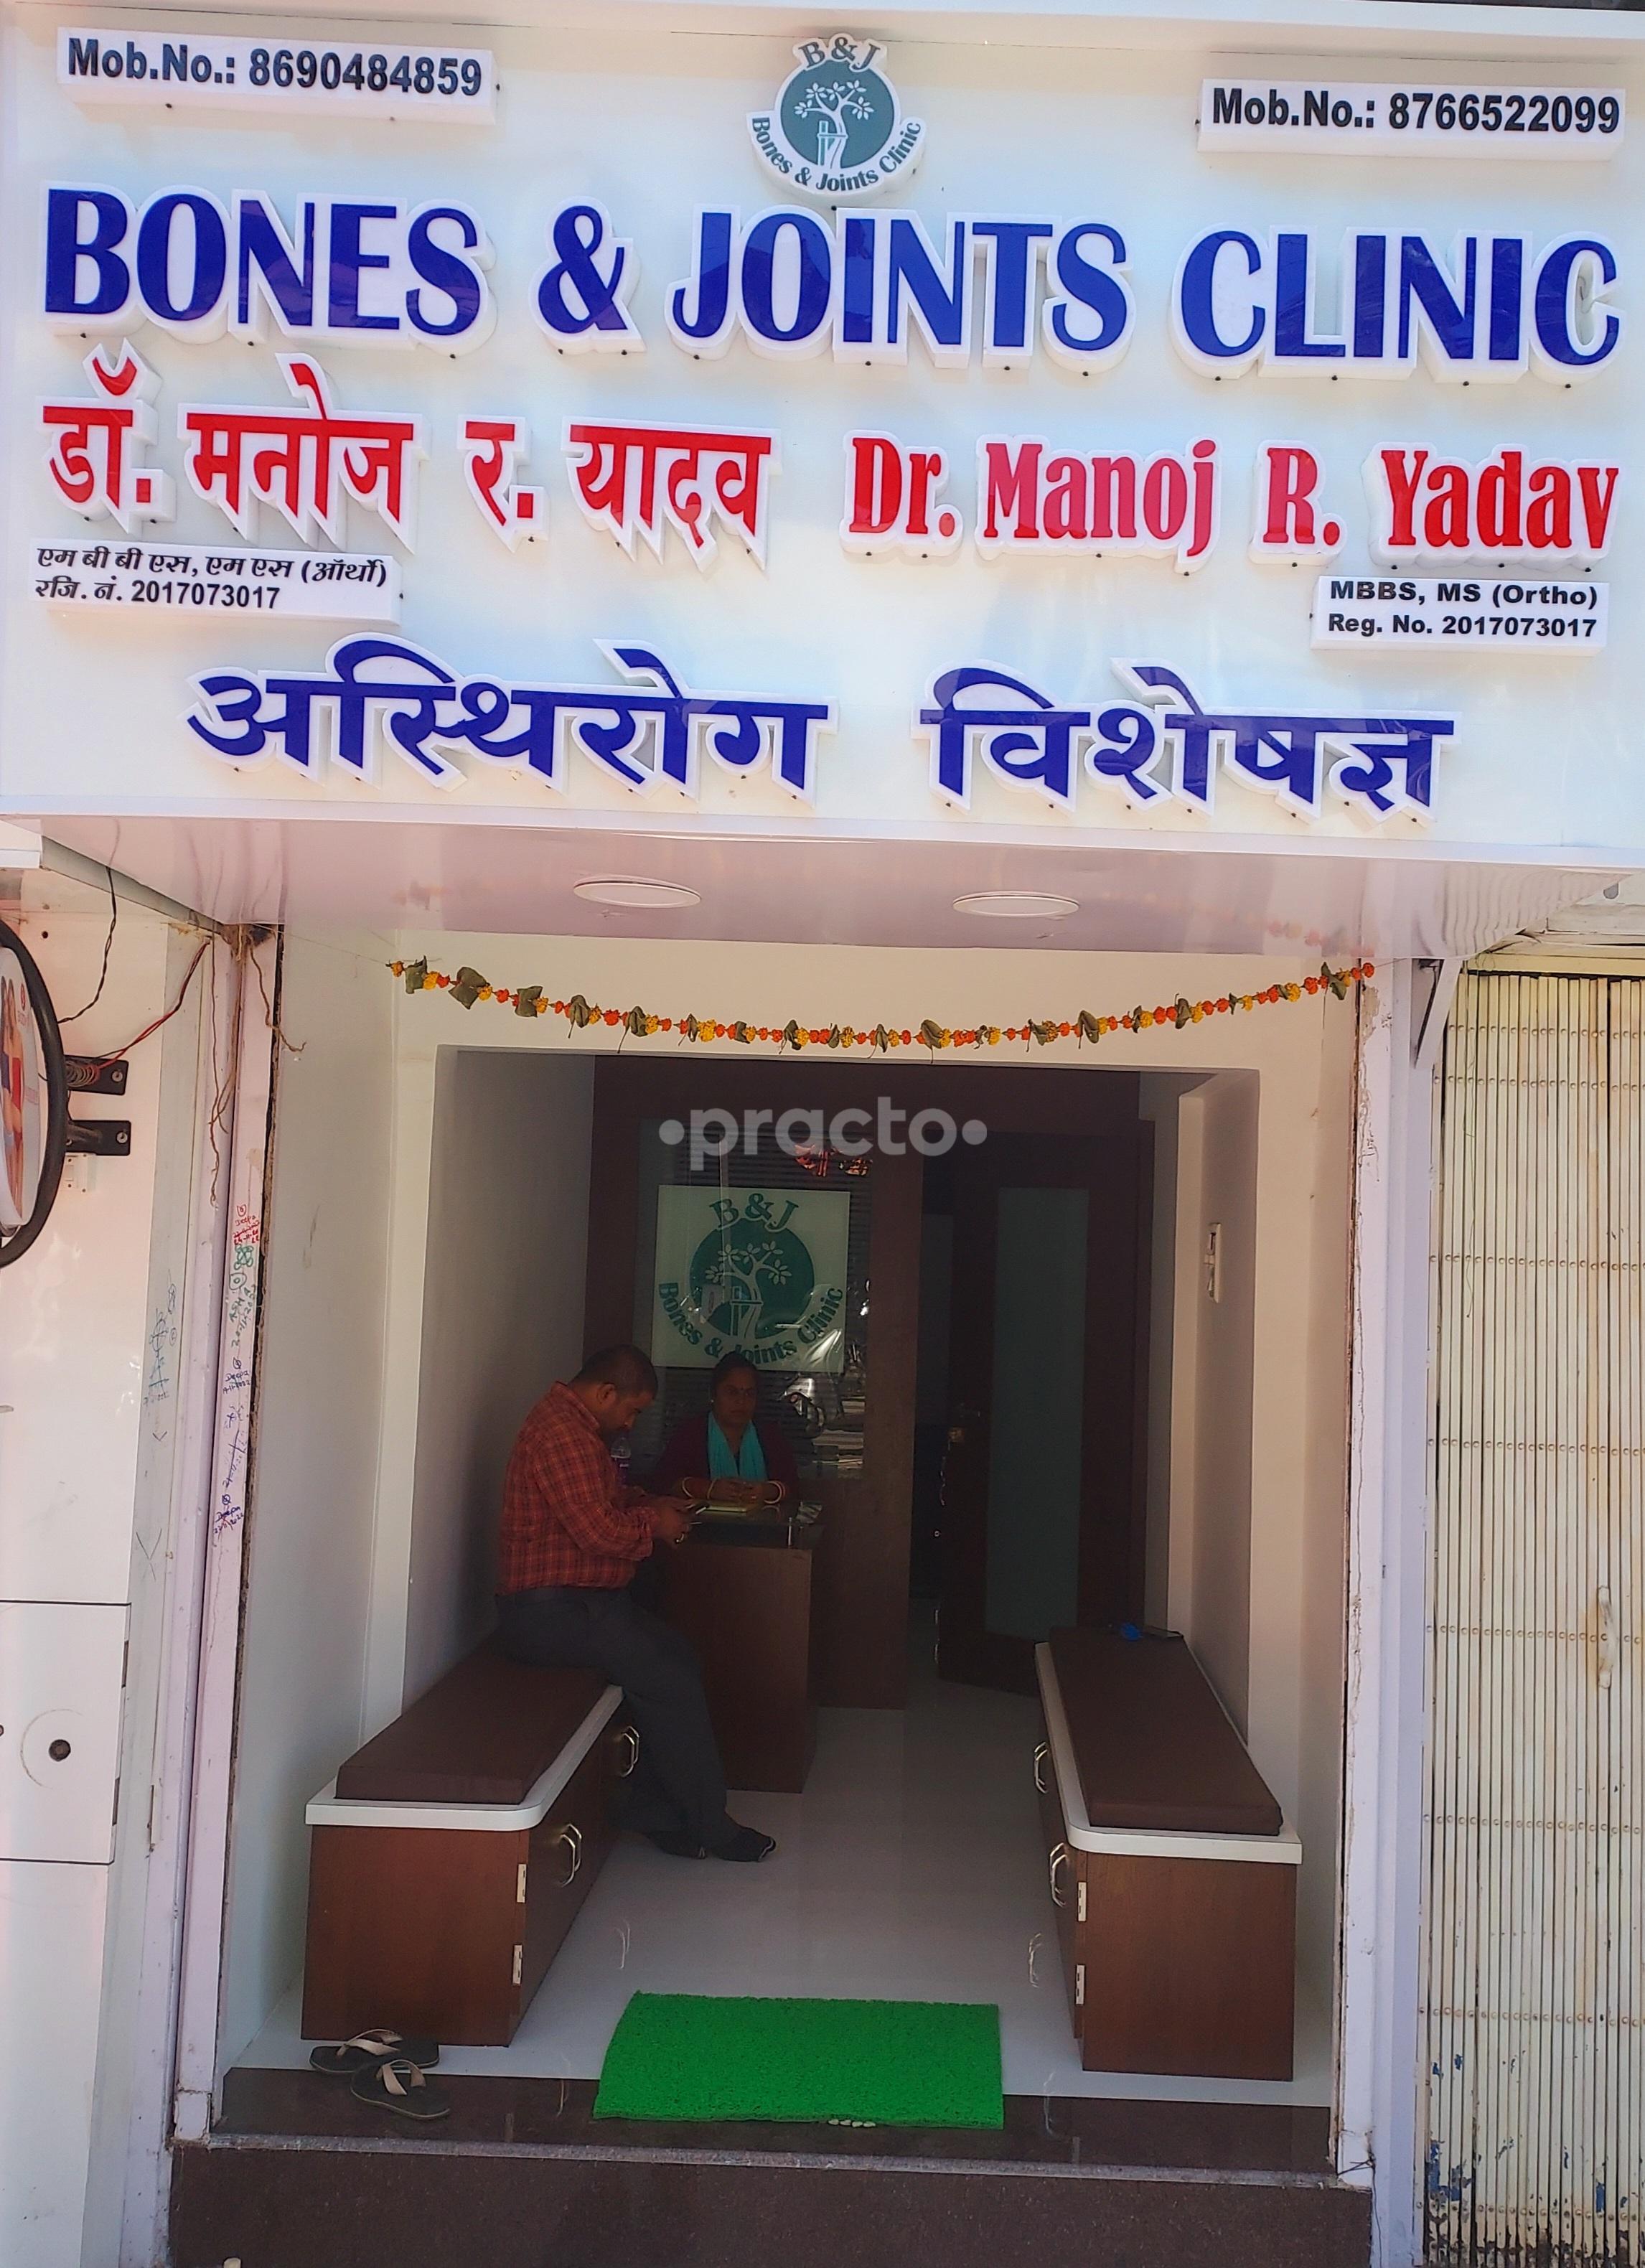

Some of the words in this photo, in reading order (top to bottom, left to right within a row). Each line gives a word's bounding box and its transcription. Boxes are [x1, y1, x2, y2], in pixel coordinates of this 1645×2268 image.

[68, 38, 235, 84] Mob.No.:
[249, 48, 482, 95] 8690484859
[1212, 88, 1374, 128] Mob.No.:
[1389, 93, 1619, 133] 8766522099
[752, 117, 793, 174] Bones
[795, 167, 812, 186] &
[815, 169, 878, 192] Joints
[878, 122, 921, 173] Clinic
[45, 188, 481, 335] BONES
[538, 205, 627, 334] &
[672, 212, 1127, 352] JOINTS
[1181, 230, 1619, 366] CLINIC
[43, 356, 151, 509] डॉ.
[187, 362, 413, 523] मनोज
[466, 421, 533, 526] र.
[570, 424, 771, 548] यादव
[848, 437, 955, 538] Dr.
[983, 439, 1217, 558] Manoj
[1262, 447, 1340, 546] R.
[1380, 450, 1619, 549] Yadav
[37, 548, 76, 568] एम
[82, 545, 109, 569] बी
[115, 548, 142, 571] बी
[205, 556, 247, 576] एम
[250, 557, 294, 578] एस
[131, 580, 281, 609] 2017073017
[1328, 613, 1382, 637] Reg.
[1392, 615, 1432, 634] No.
[1442, 616, 1597, 637] 2017073017
[1331, 581, 1425, 605] MBBS,
[1438, 583, 1481, 602] MS
[1492, 584, 1597, 610] (Ortho)
[187, 639, 828, 789] अस्थिरोग
[920, 665, 1454, 812] विशेषज्ञ
[659, 1283, 703, 1345] Bones
[704, 1337, 723, 1358] &
[797, 1288, 843, 1344] Clinic
